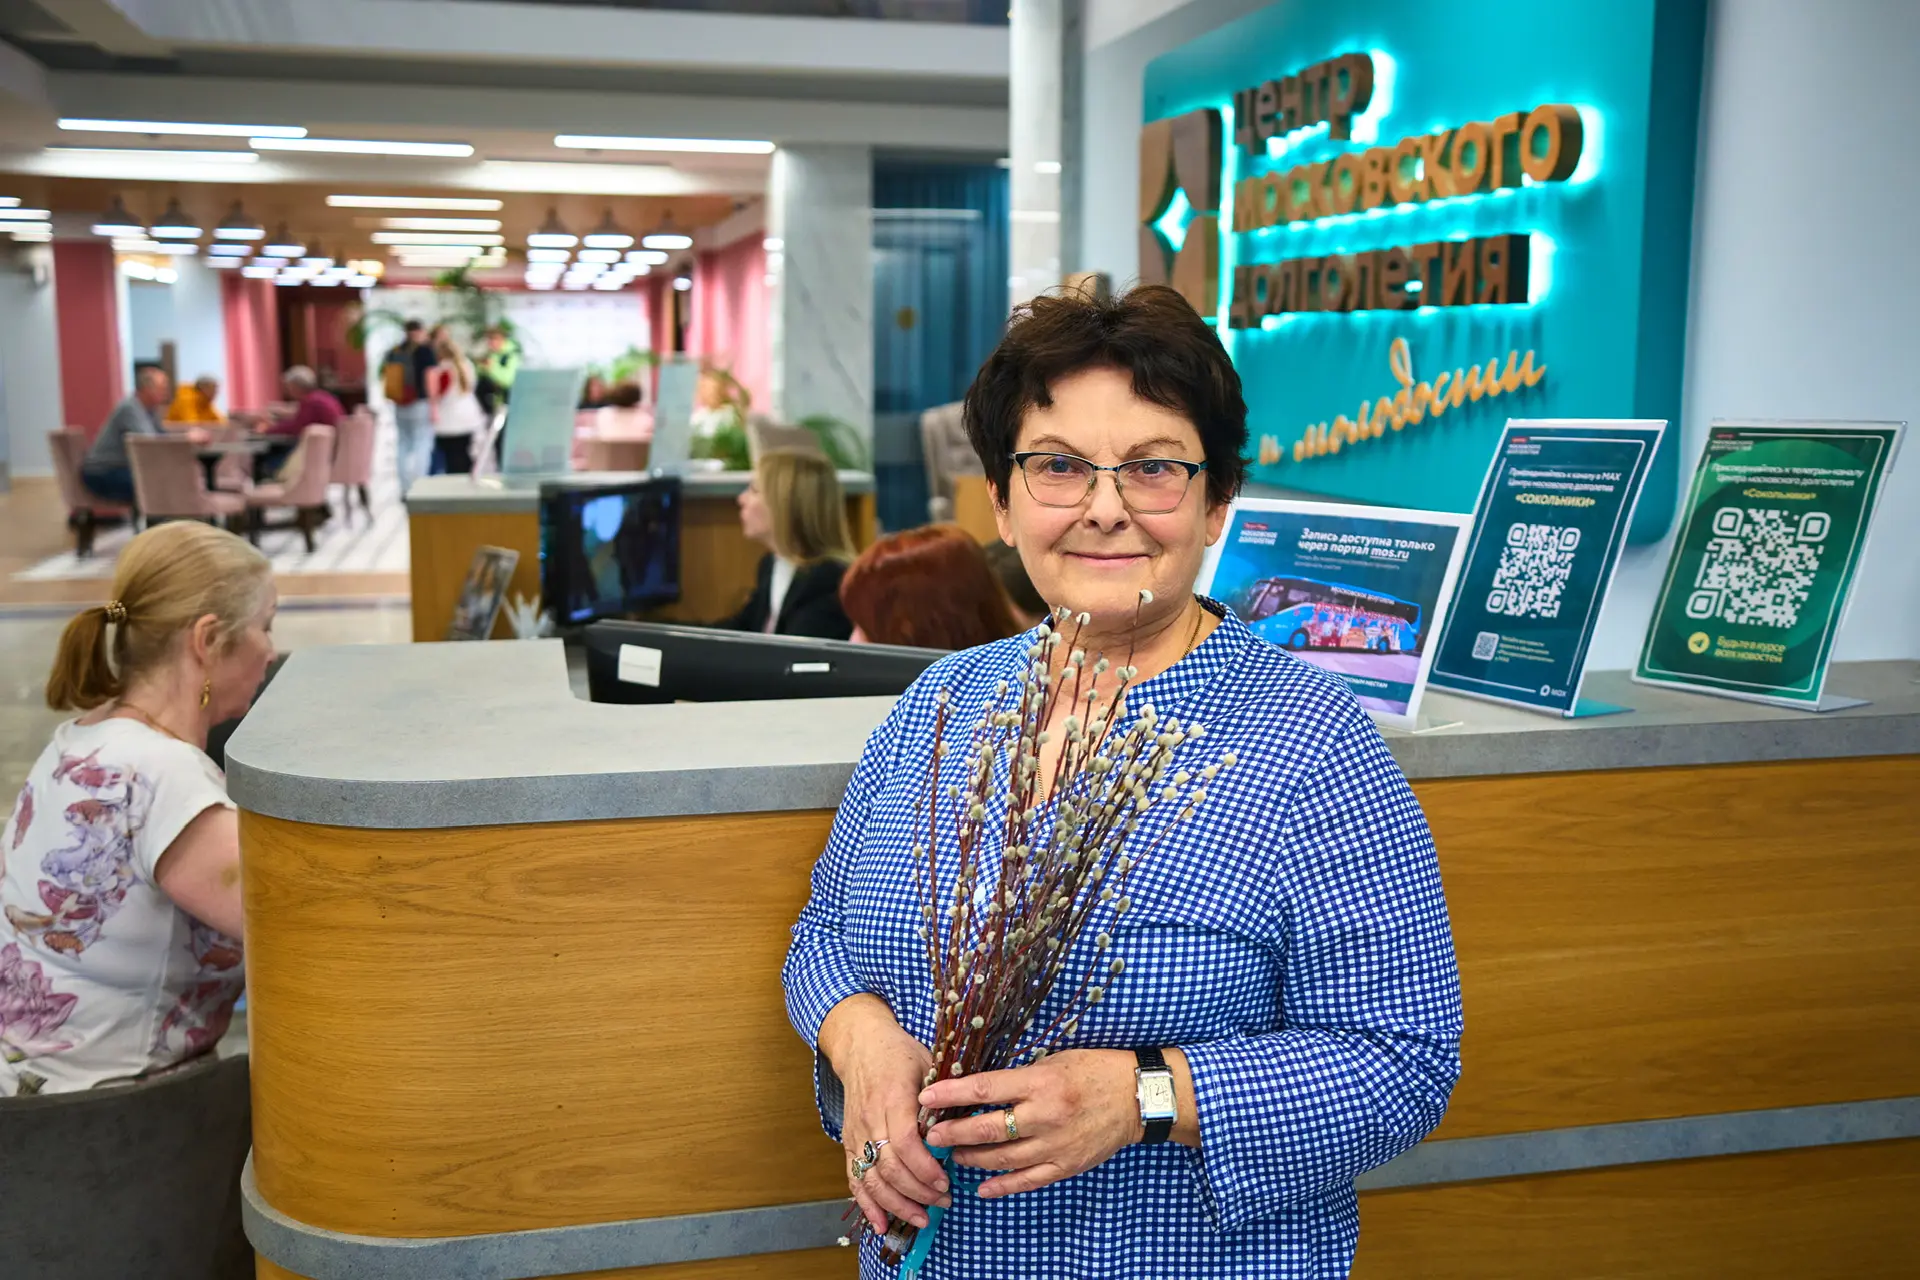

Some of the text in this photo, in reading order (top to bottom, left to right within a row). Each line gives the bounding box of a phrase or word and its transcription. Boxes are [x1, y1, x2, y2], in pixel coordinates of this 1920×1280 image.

[1294, 338, 1547, 462] молодости
[1602, 472, 1622, 481] MAX
[1301, 527, 1436, 551] Запись доступна только
[1297, 541, 1410, 560] через портал mos.ru
